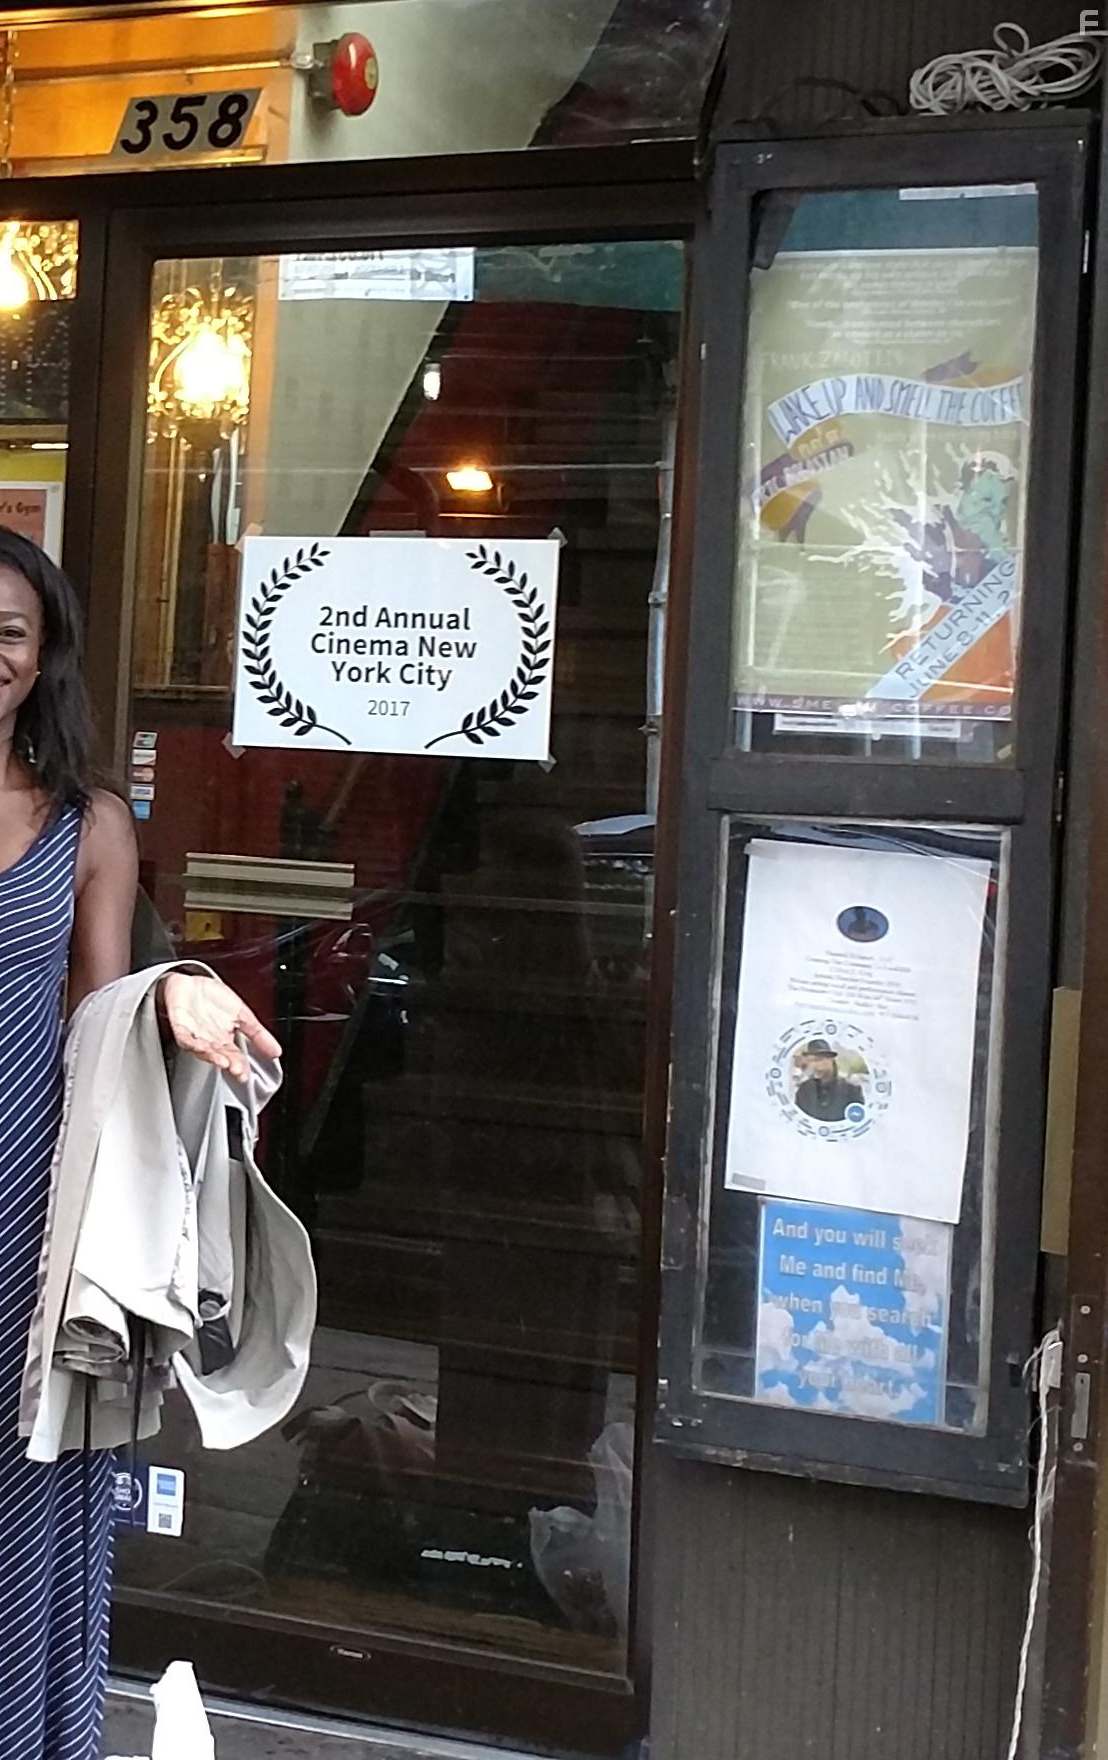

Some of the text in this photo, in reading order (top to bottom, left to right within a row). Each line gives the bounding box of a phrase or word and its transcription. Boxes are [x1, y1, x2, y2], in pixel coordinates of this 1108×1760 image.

[120, 94, 249, 154] 358
[855, 377, 884, 410] AND
[885, 380, 930, 419] SMELL
[938, 390, 964, 424] THE
[319, 605, 470, 631] 2nd Annual
[896, 560, 1015, 680] RETURNING
[311, 632, 476, 659] Cinema New
[331, 661, 452, 692] York City
[909, 648, 958, 698] JUNE
[367, 700, 410, 717] 2017
[772, 1218, 808, 1239] And
[814, 1226, 847, 1246] you
[853, 1229, 886, 1249] will
[779, 1254, 807, 1276] Me
[812, 1261, 847, 1281] and
[852, 1263, 888, 1285] find
[771, 1292, 823, 1313] when
